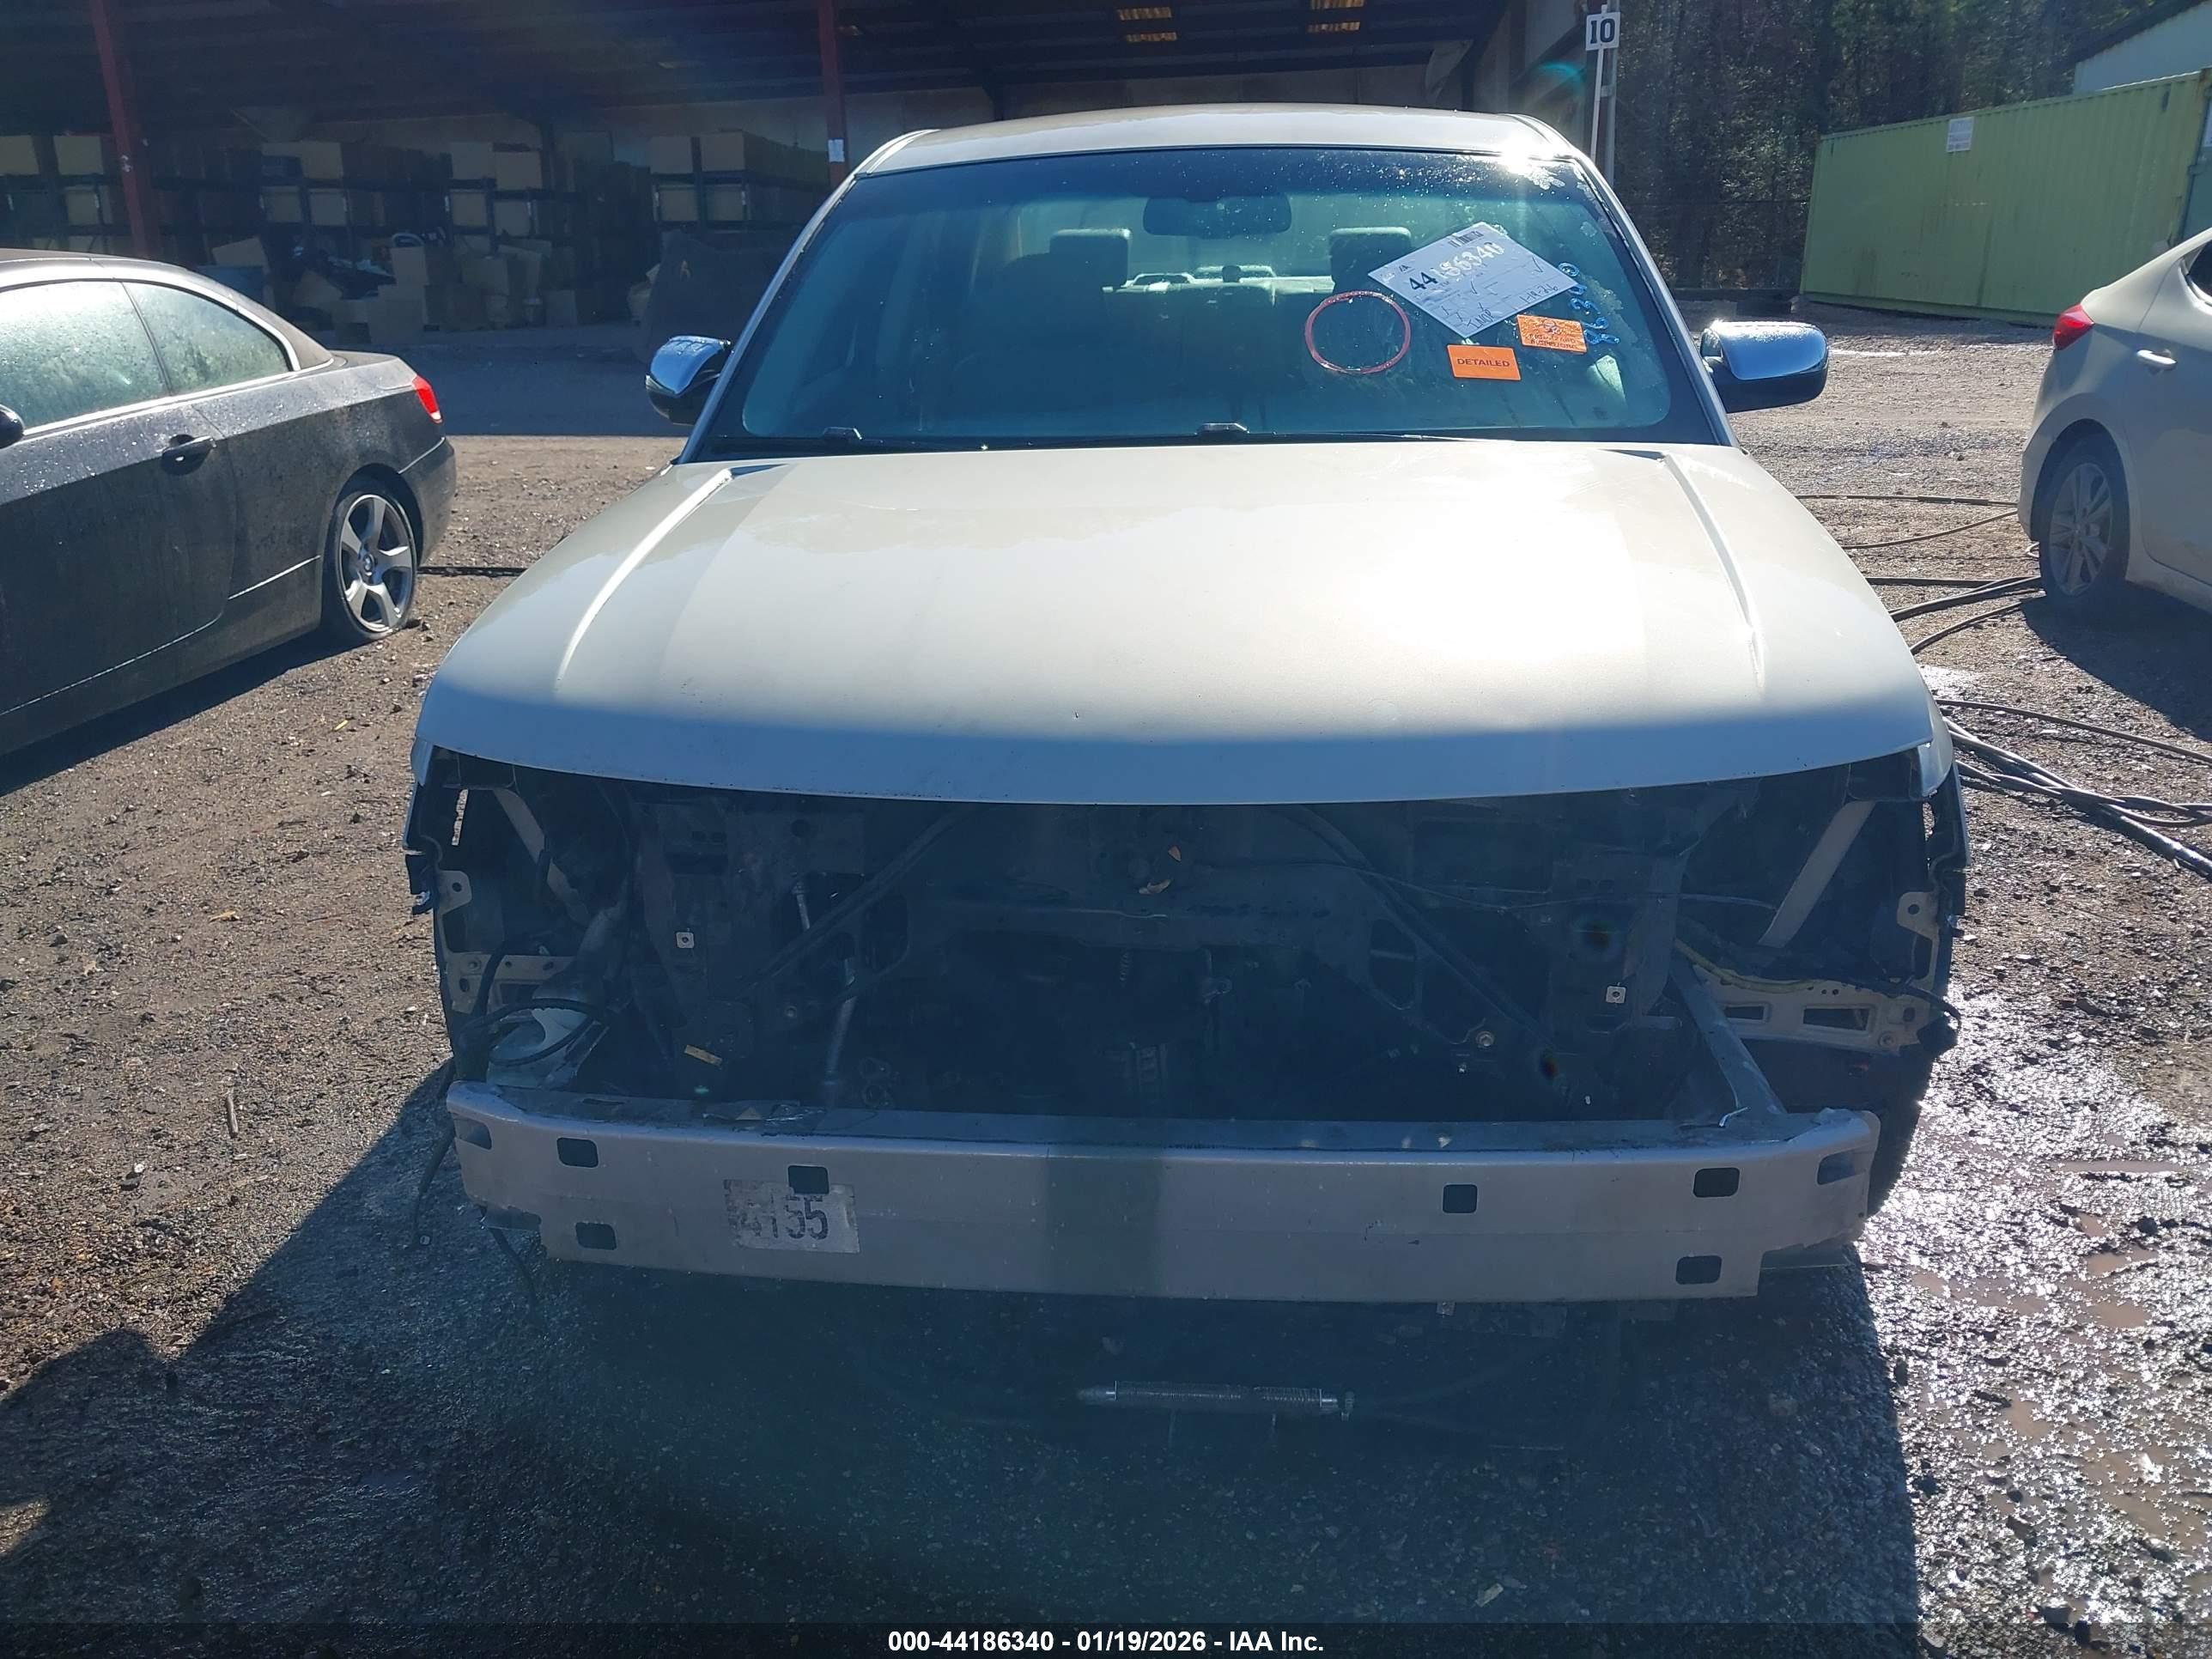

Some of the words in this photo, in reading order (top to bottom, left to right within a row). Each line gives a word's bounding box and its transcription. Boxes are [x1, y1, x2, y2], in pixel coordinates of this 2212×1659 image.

[1589, 18, 1615, 44] 10
[1409, 241, 1505, 290] 44186340
[1456, 357, 1511, 368] DETAILED
